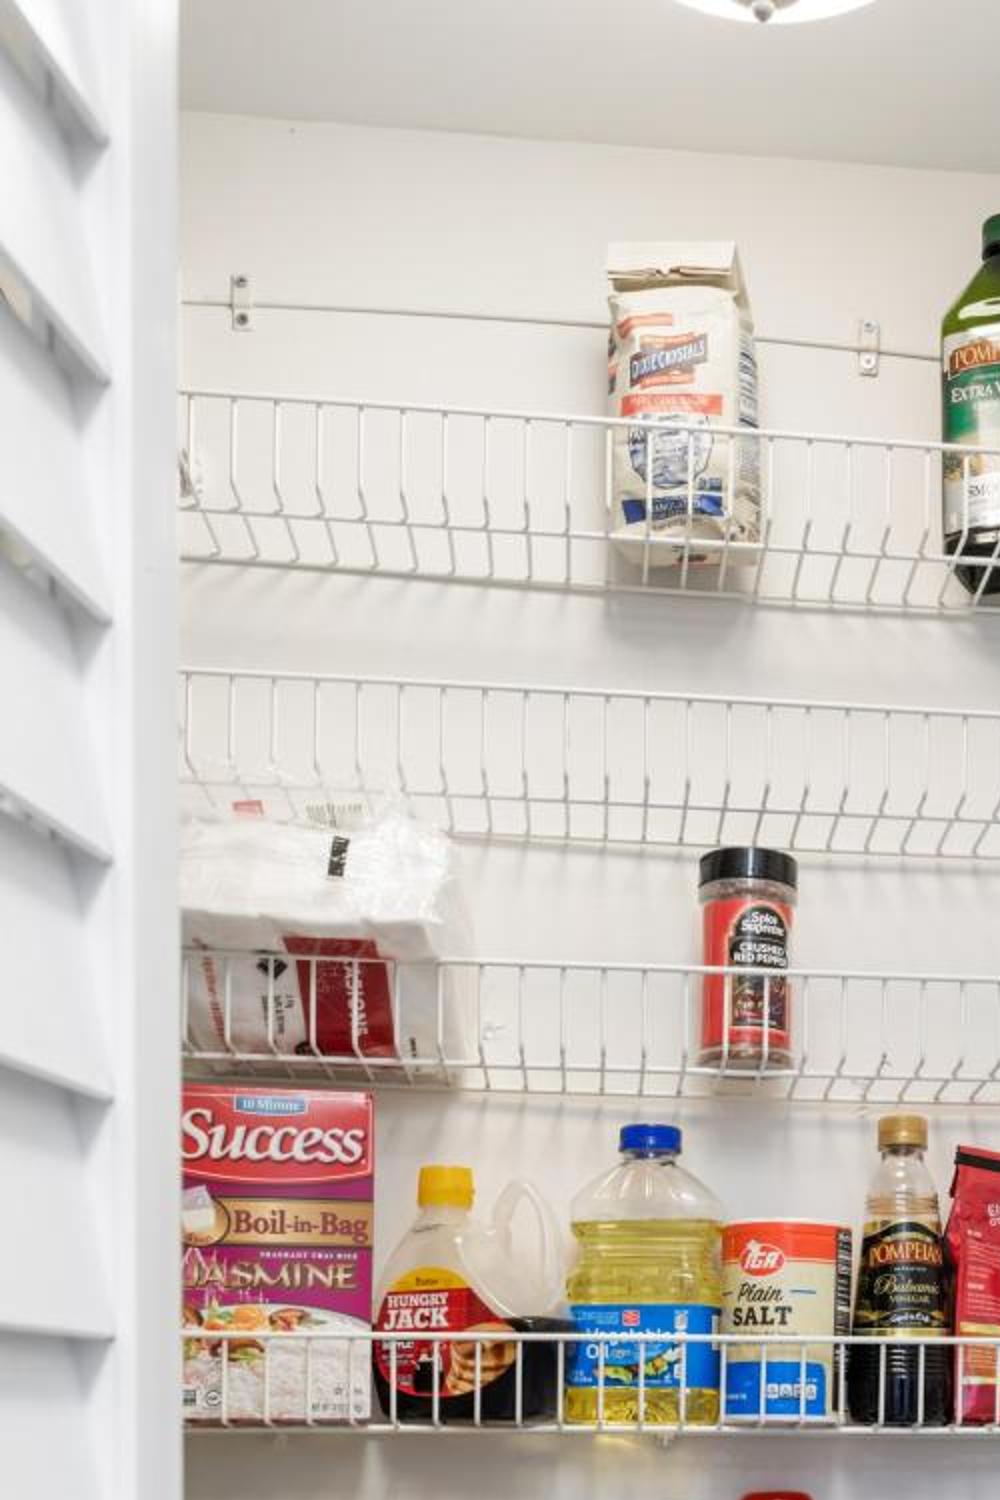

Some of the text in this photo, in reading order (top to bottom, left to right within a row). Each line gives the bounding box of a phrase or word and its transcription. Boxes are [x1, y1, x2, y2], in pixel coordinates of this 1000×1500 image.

[951, 383, 993, 403] EXTRA
[182, 1108, 366, 1165] Success
[233, 1210, 368, 1244] Boil-in-Bag
[386, 1292, 449, 1309] HUNGRY
[383, 1306, 449, 1331] JACK
[733, 1305, 793, 1327] SALT
[586, 1342, 609, 1359] Ol
